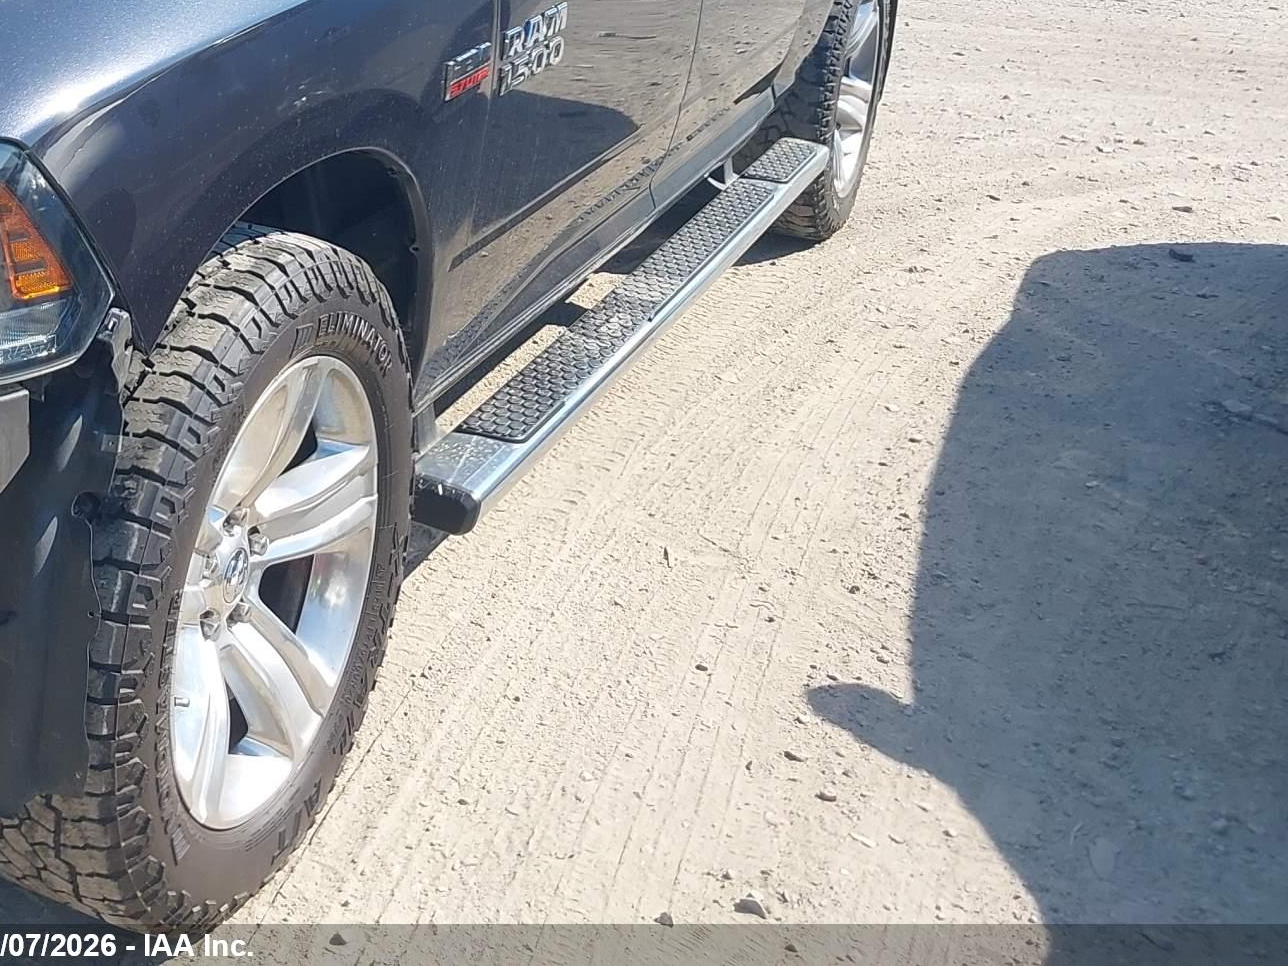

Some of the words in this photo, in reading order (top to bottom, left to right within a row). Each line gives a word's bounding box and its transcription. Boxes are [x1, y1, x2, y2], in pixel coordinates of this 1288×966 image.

[502, 1, 568, 58] RAM
[499, 35, 565, 97] 1500
[316, 311, 393, 378] ELIMINATOR
